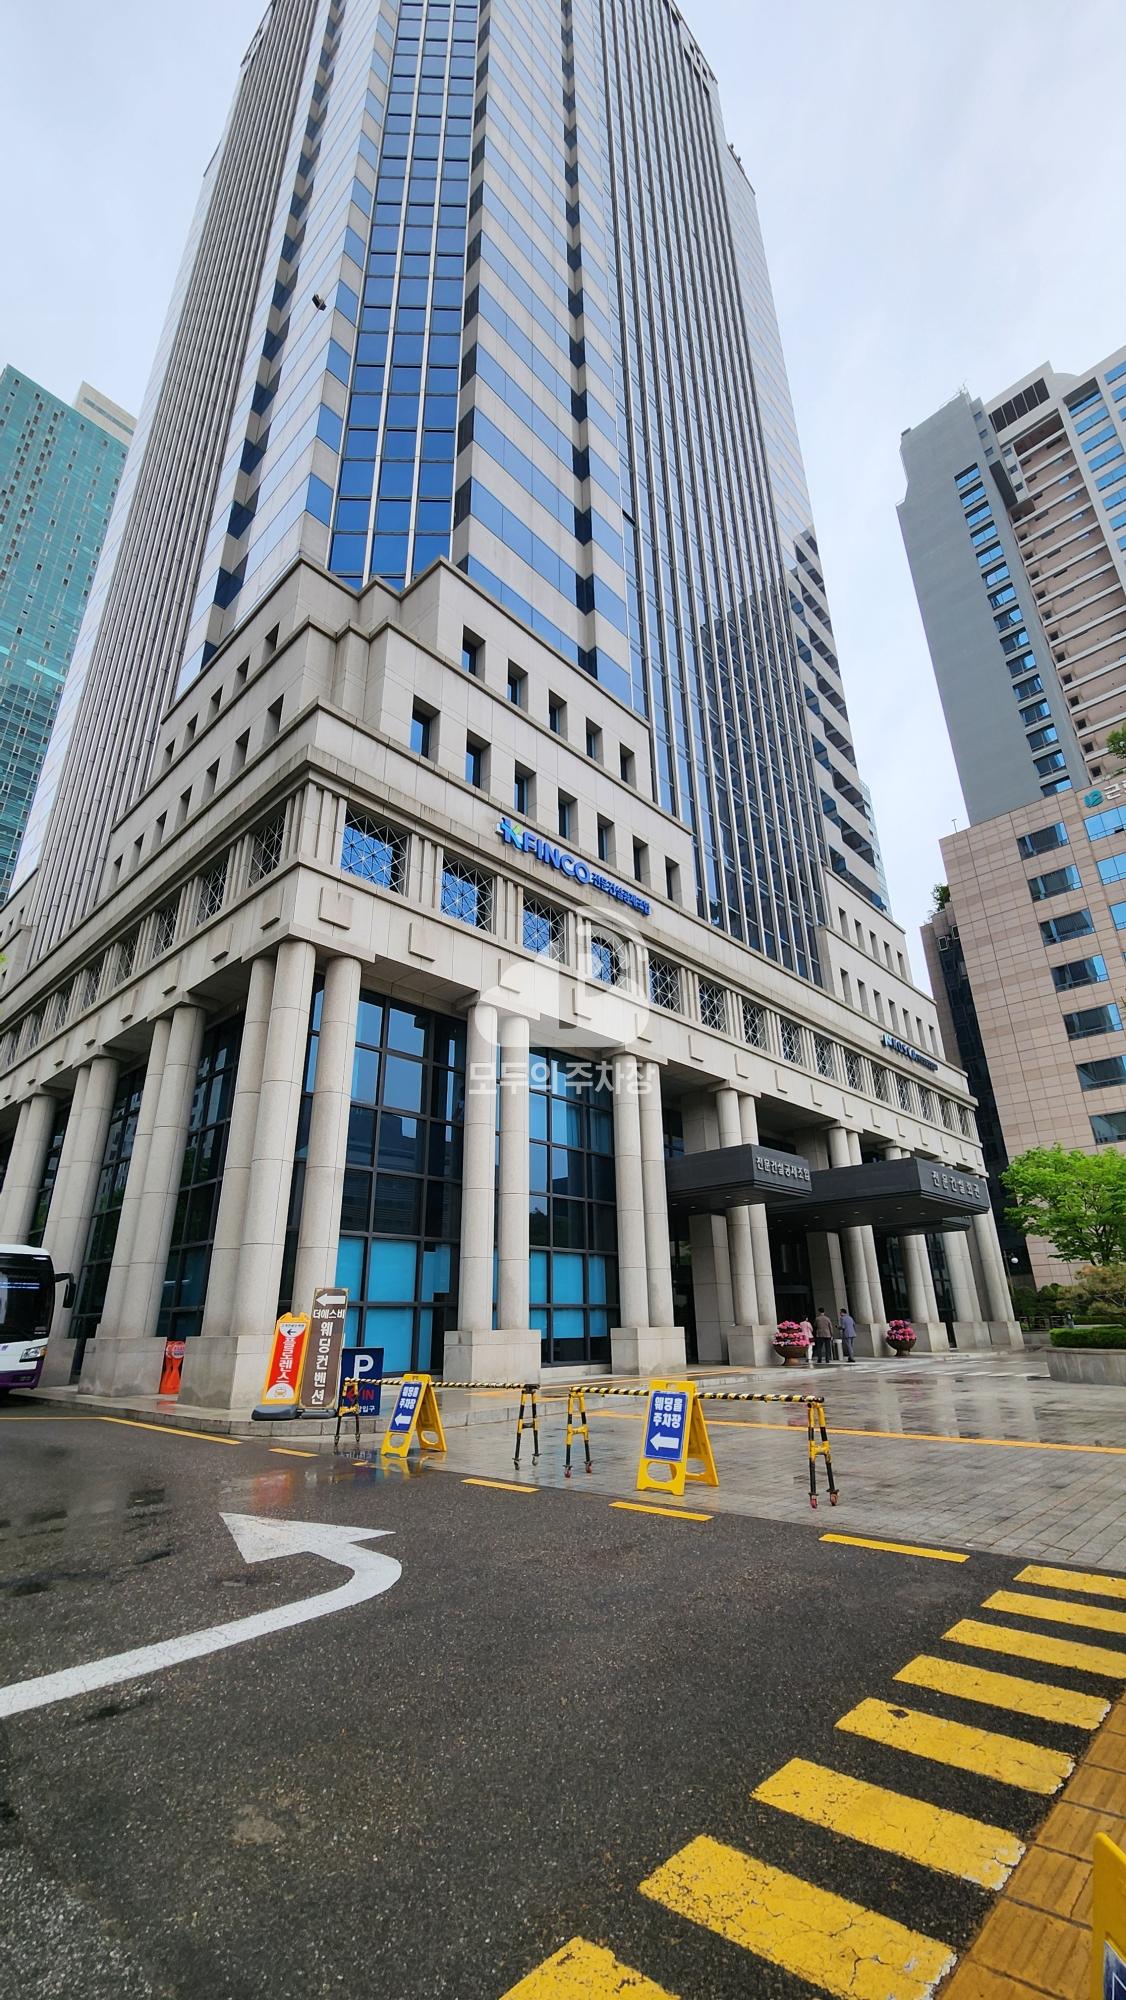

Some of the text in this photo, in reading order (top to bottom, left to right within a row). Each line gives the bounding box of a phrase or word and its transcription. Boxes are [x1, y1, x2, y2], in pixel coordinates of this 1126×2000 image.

[756, 1157, 810, 1181] 전문건설공제조합
[932, 1170, 980, 1199] 전문건설회관
[311, 1321, 334, 1405] 웨딩컨벤션
[353, 1354, 374, 1379] P
[654, 1396, 683, 1412] 웨딩홀
[653, 1412, 682, 1429] 주차장
